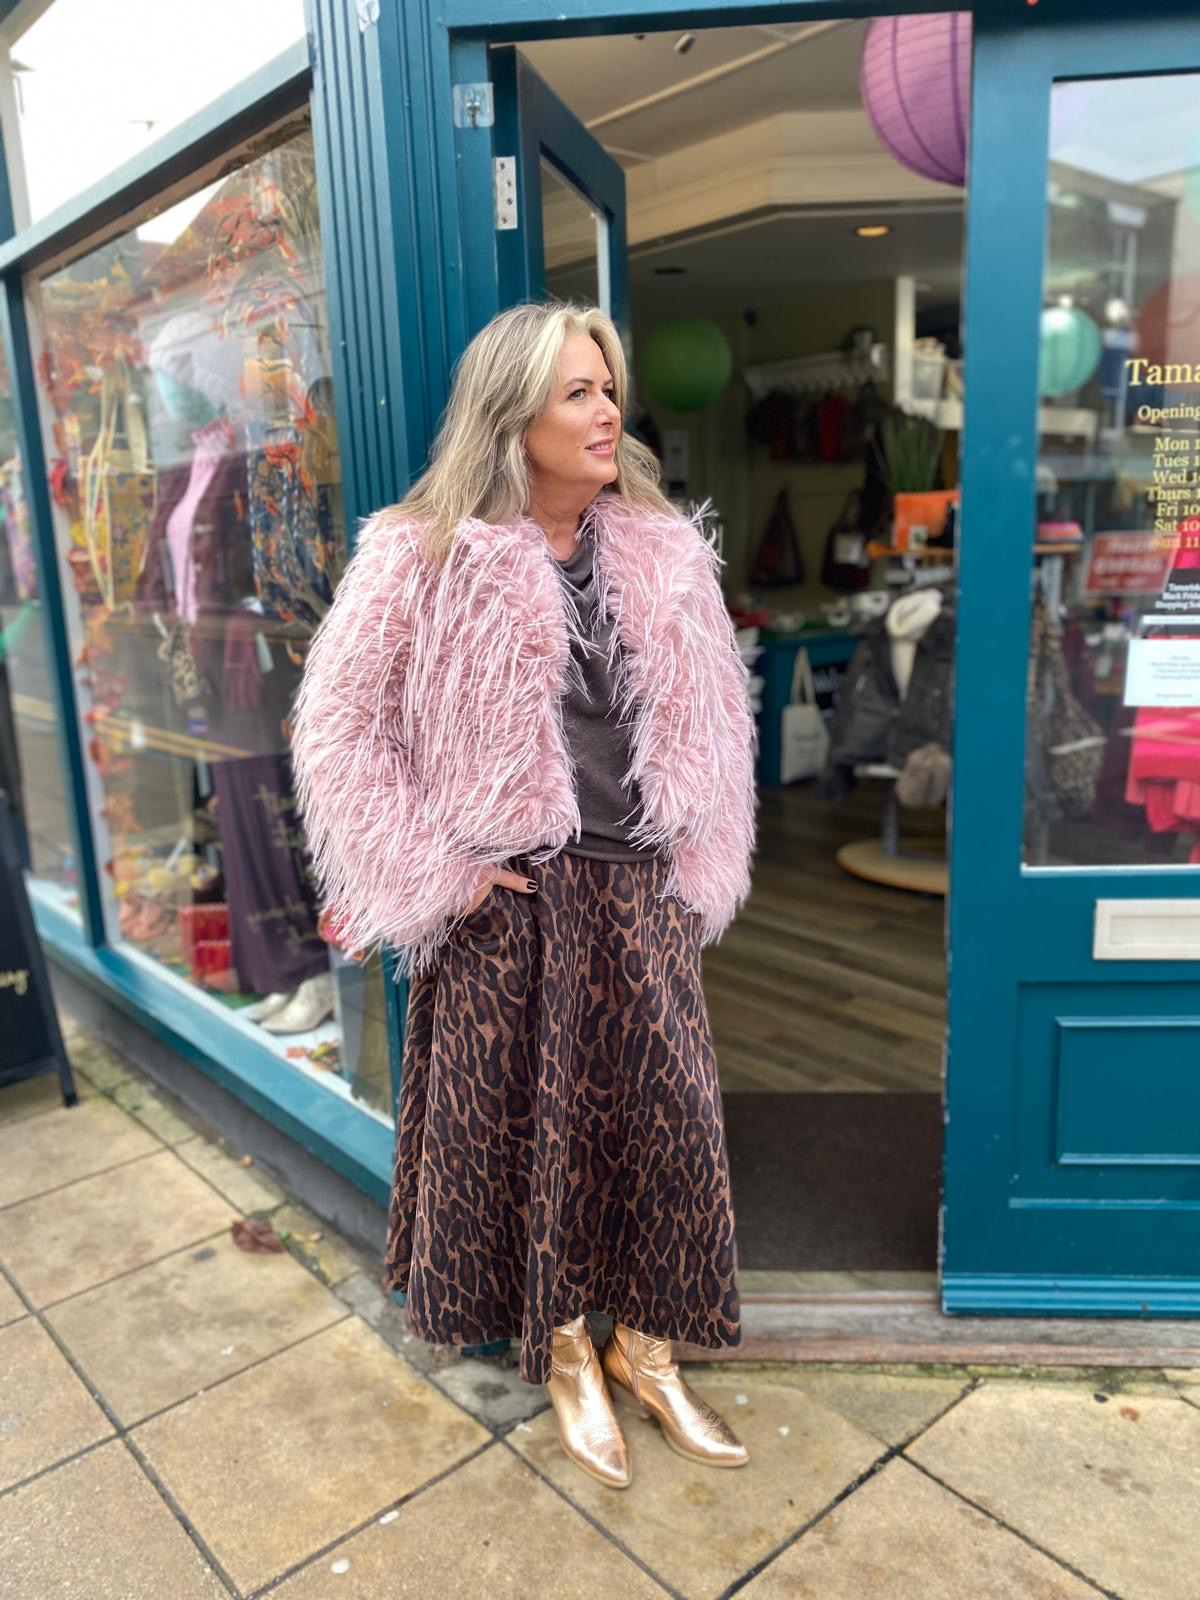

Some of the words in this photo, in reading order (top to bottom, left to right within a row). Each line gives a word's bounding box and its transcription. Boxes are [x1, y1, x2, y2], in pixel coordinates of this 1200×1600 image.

[1137, 403, 1200, 424] Opening
[1155, 437, 1189, 451] Mon
[1152, 453, 1189, 468] Tues
[1153, 468, 1187, 484] Wed
[1192, 471, 1200, 483] 1
[1146, 486, 1191, 502] Thurs
[1156, 501, 1178, 516] Fri
[1154, 518, 1177, 532] Sat
